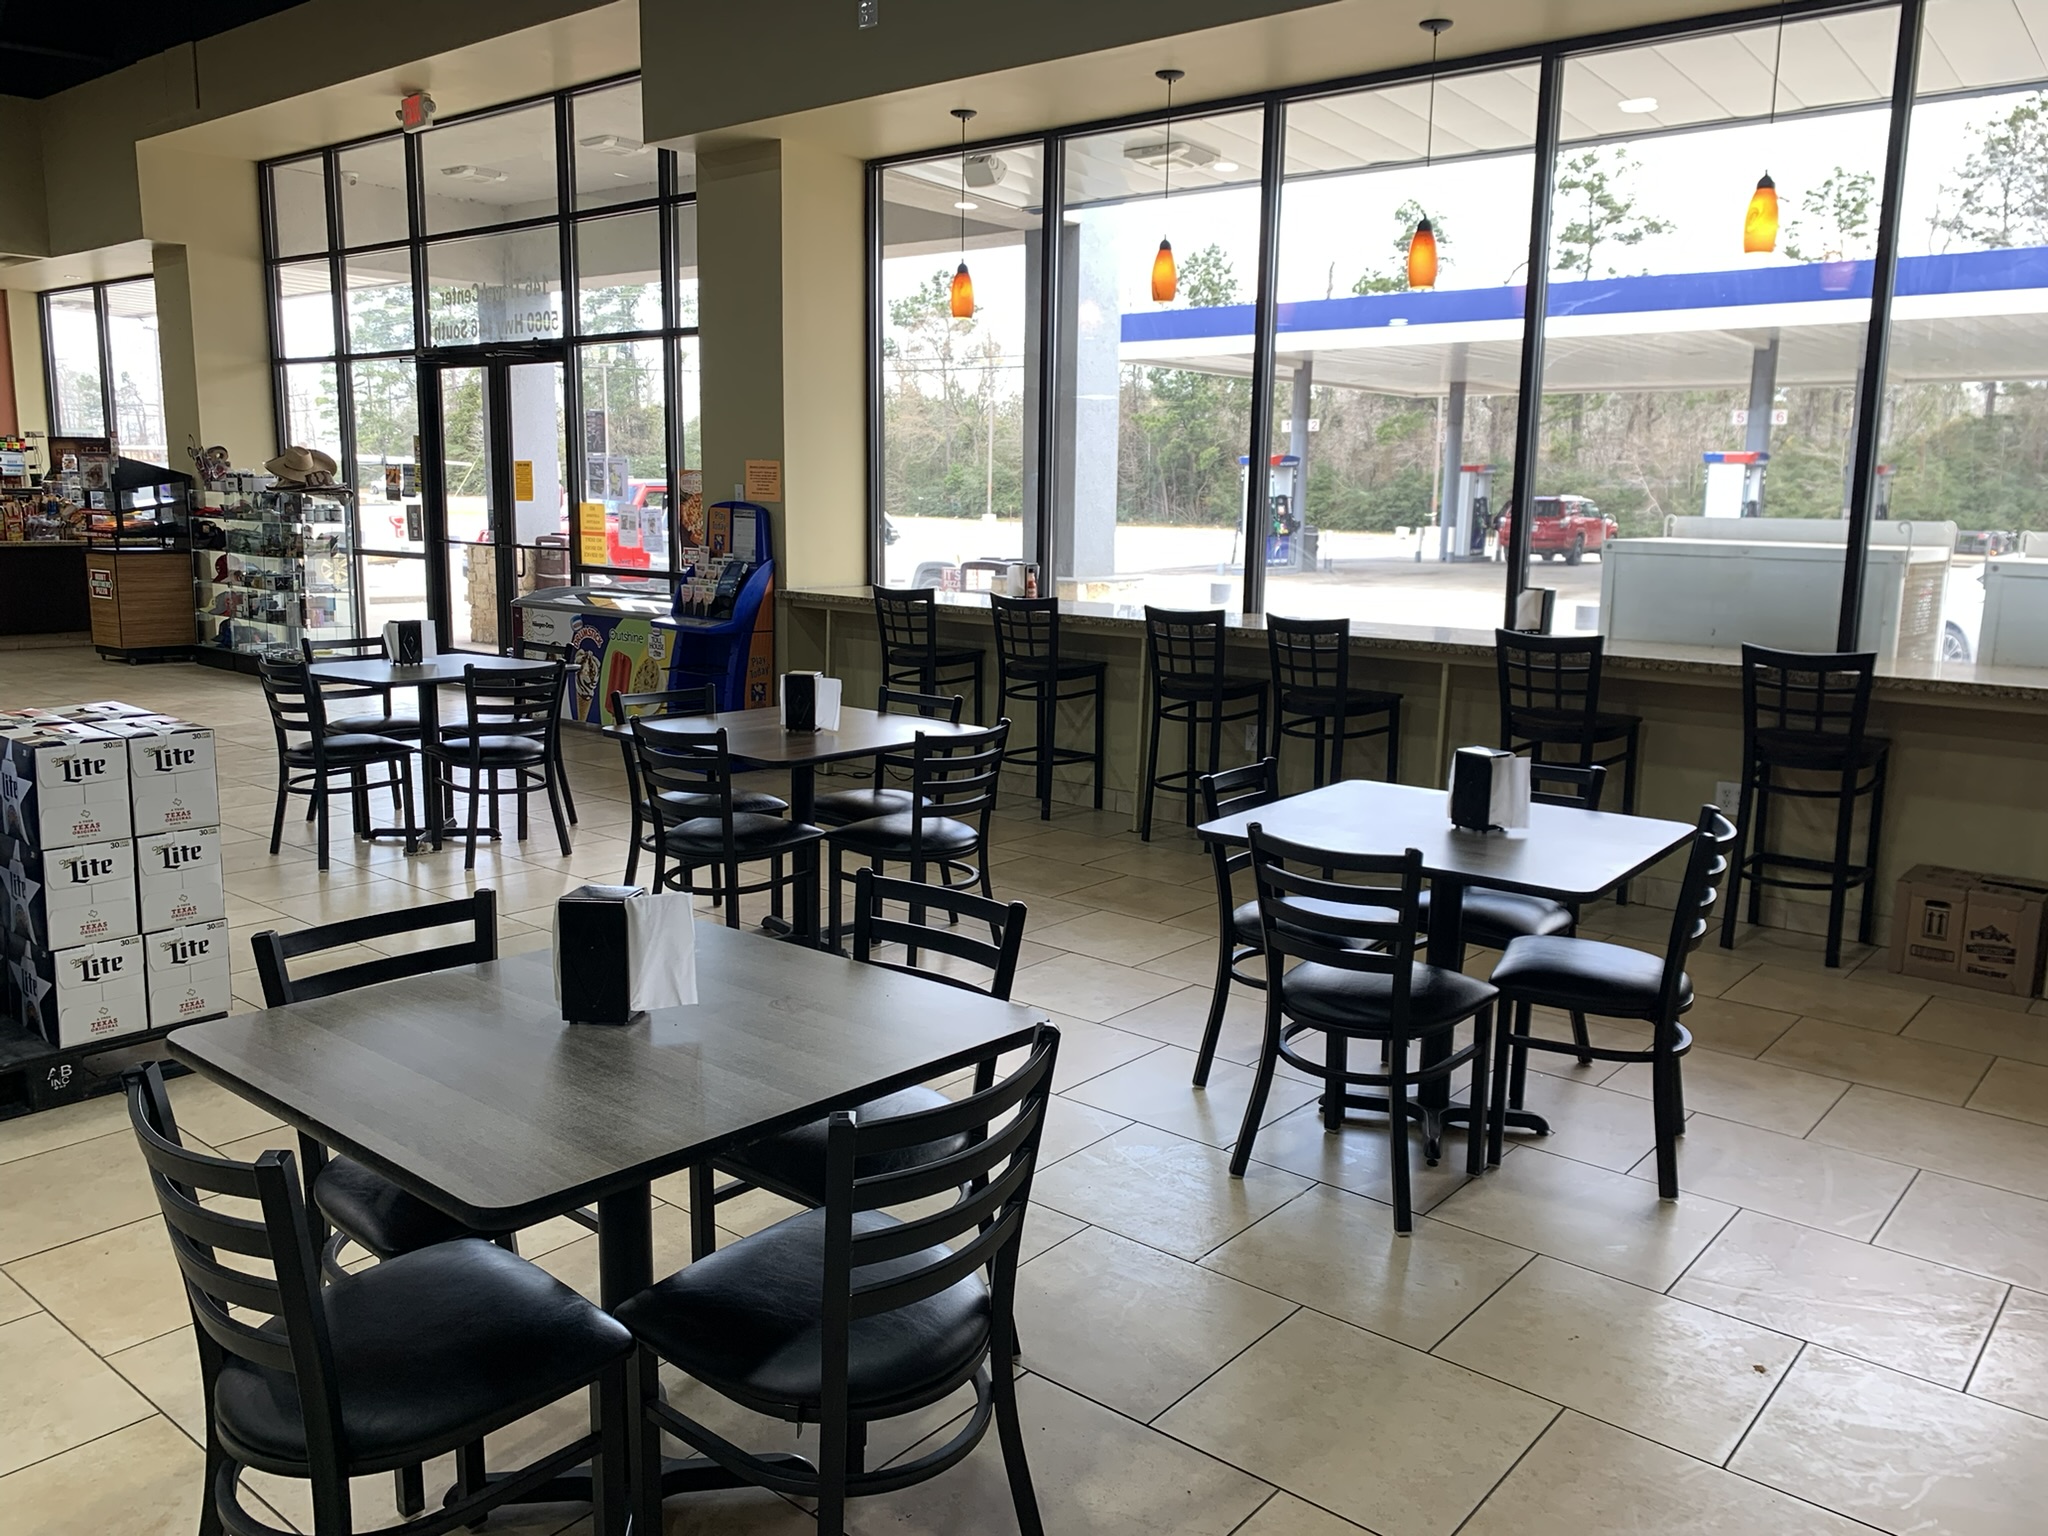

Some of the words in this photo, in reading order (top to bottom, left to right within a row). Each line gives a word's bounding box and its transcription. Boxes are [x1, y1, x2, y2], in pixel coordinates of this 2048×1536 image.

[572, 627, 604, 649] DRUMSTICK
[609, 628, 644, 644] Outshine
[62, 758, 106, 783] Lite
[155, 748, 195, 772] Lite
[1, 772, 18, 802] Lite
[164, 810, 191, 818] TEXAS
[72, 822, 101, 831] TEXAS
[163, 845, 202, 869] Lite
[70, 858, 113, 883] Lite
[9, 870, 26, 901] Lite
[171, 906, 197, 914] TEXAS
[80, 921, 108, 931] TEXAS
[120, 939, 130, 947] 30
[170, 939, 209, 964] Lite
[81, 956, 123, 982] Lite
[21, 968, 38, 998] Lite
[179, 999, 205, 1009] TEXAS
[90, 1018, 118, 1028] TEXAS
[50, 1076, 70, 1087] INC
